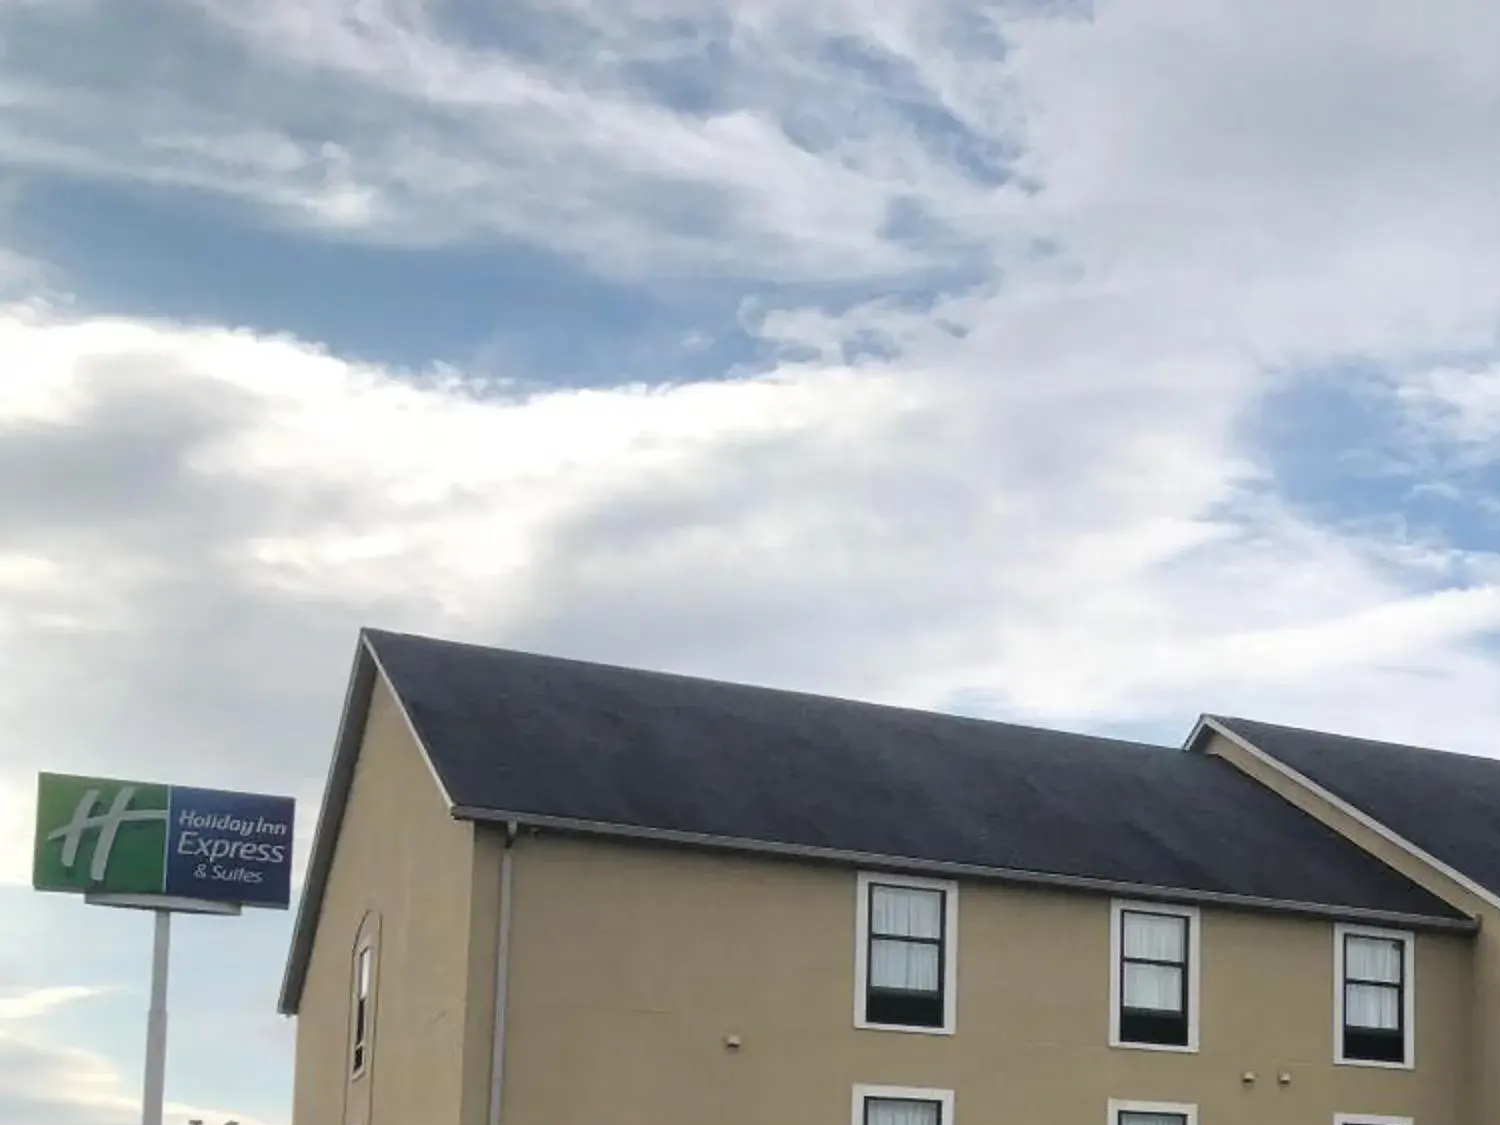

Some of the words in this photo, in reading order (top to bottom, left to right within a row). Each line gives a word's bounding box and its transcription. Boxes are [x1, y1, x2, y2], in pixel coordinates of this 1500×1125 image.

[179, 810, 254, 836] Holiday
[257, 816, 287, 836] Inn
[178, 831, 285, 863] Express
[193, 864, 208, 879] &
[212, 865, 264, 884] Suites
